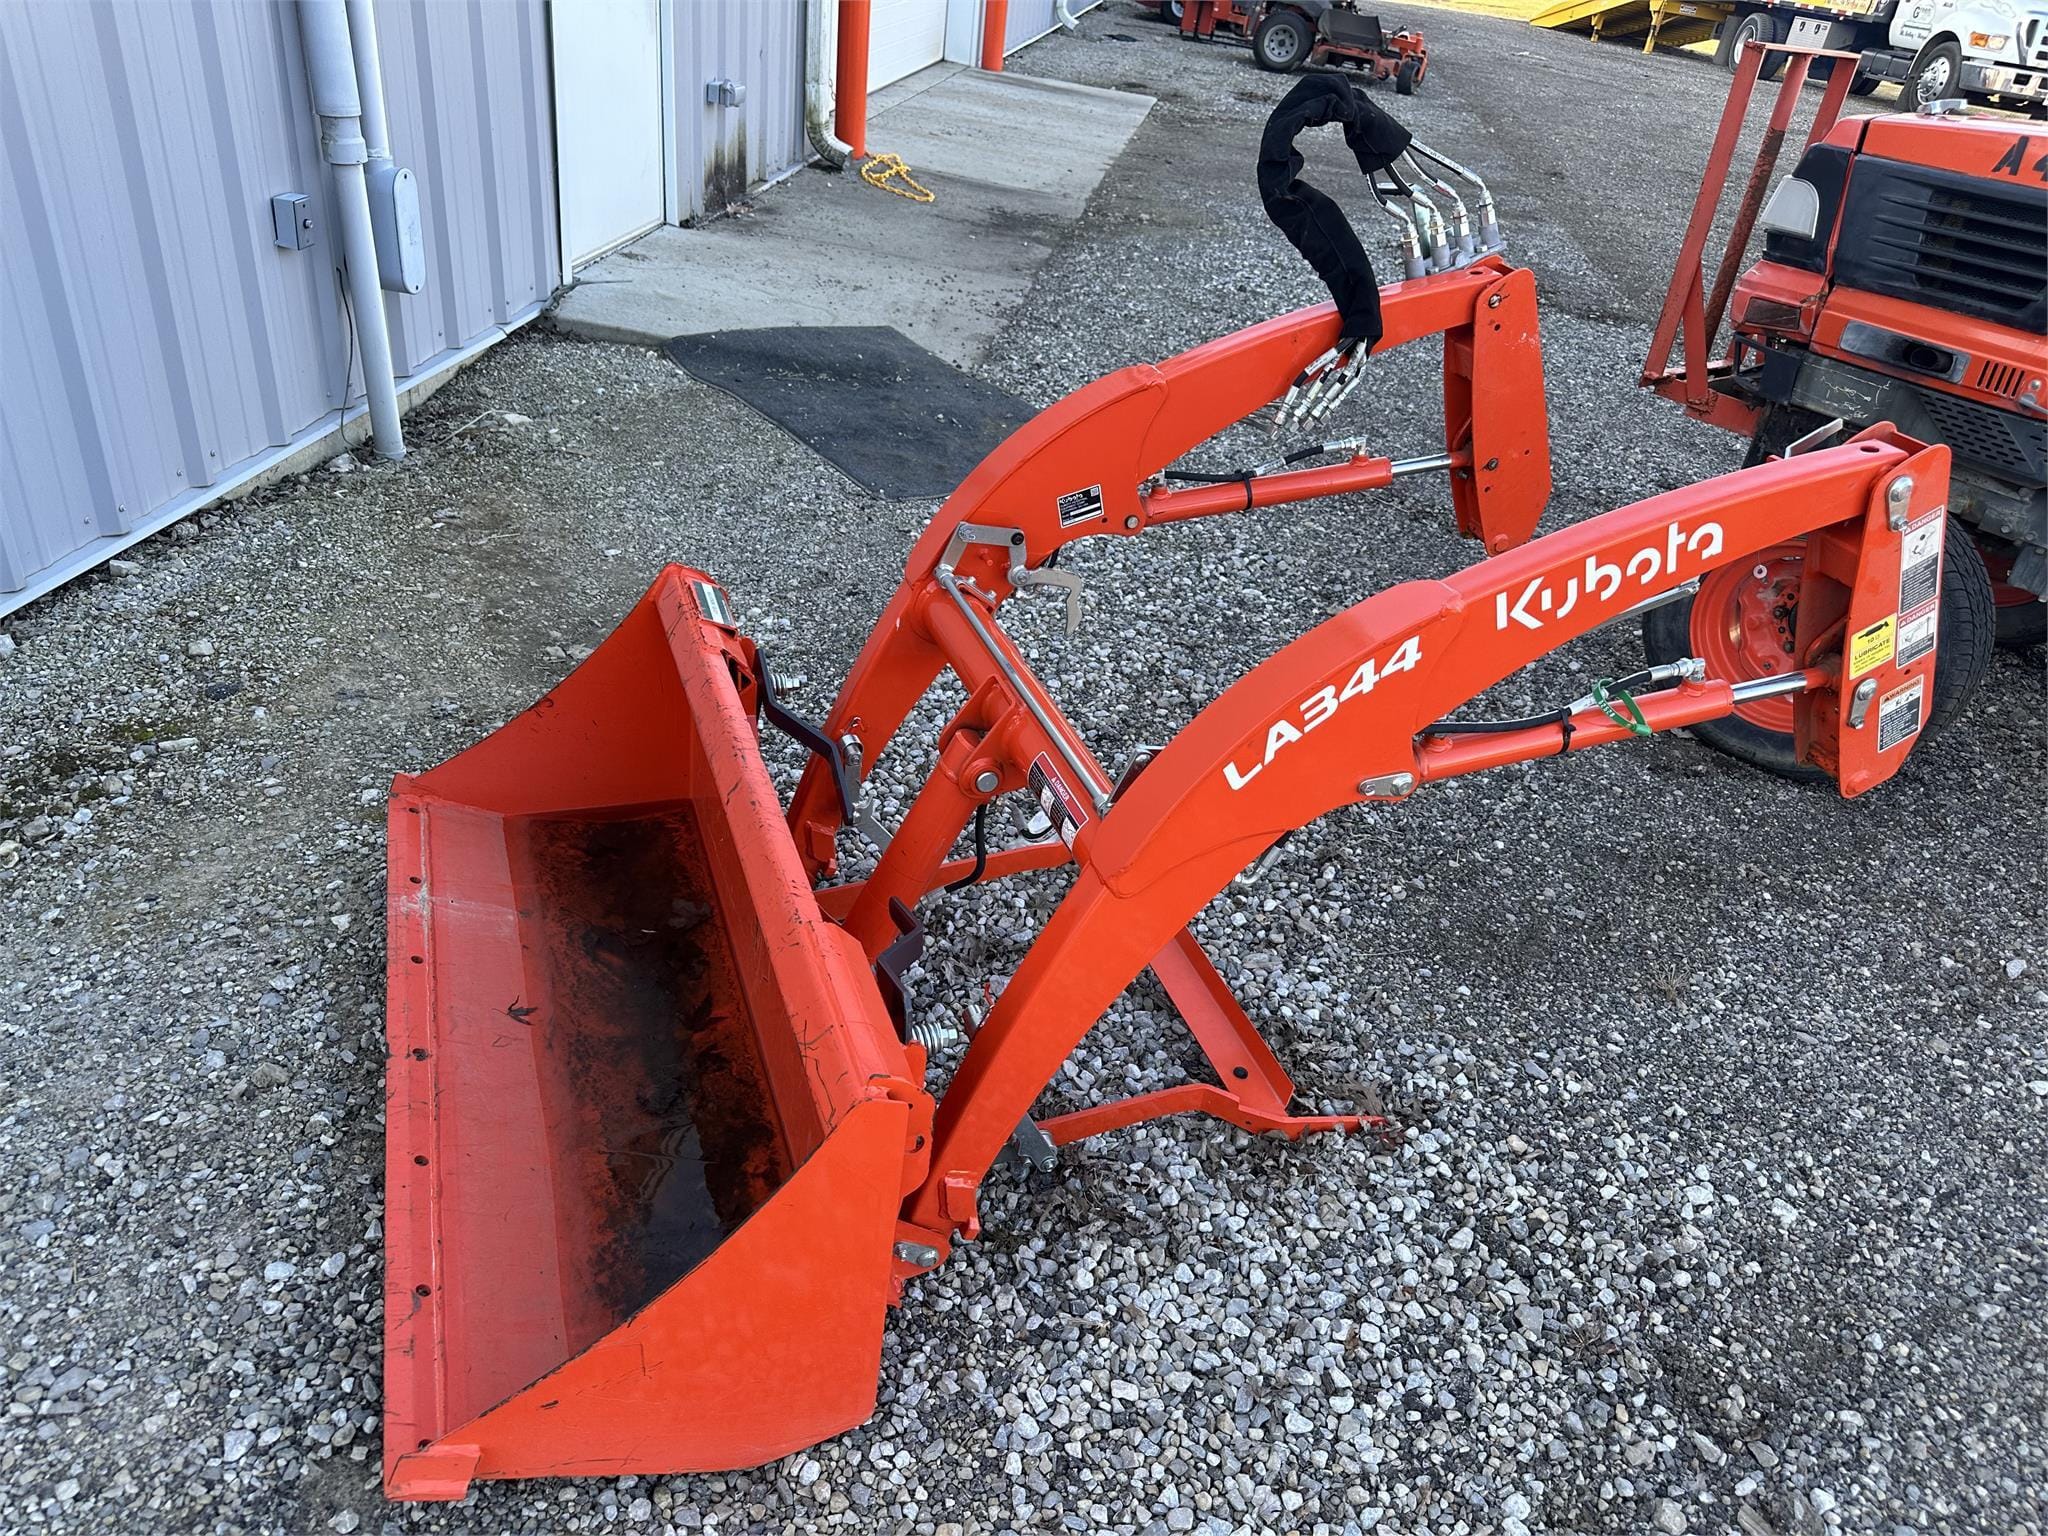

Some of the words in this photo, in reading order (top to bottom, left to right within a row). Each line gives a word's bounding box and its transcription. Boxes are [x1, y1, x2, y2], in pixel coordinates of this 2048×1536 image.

[1911, 509, 1941, 531] DANGER
[1496, 521, 1724, 631] Kubota
[1907, 604, 1935, 624] DANGER
[1854, 638, 1890, 661] LUBRICATE
[1889, 680, 1920, 699] WARNING
[1222, 635, 1423, 792] LA344
[1054, 781, 1071, 802] DANGER
